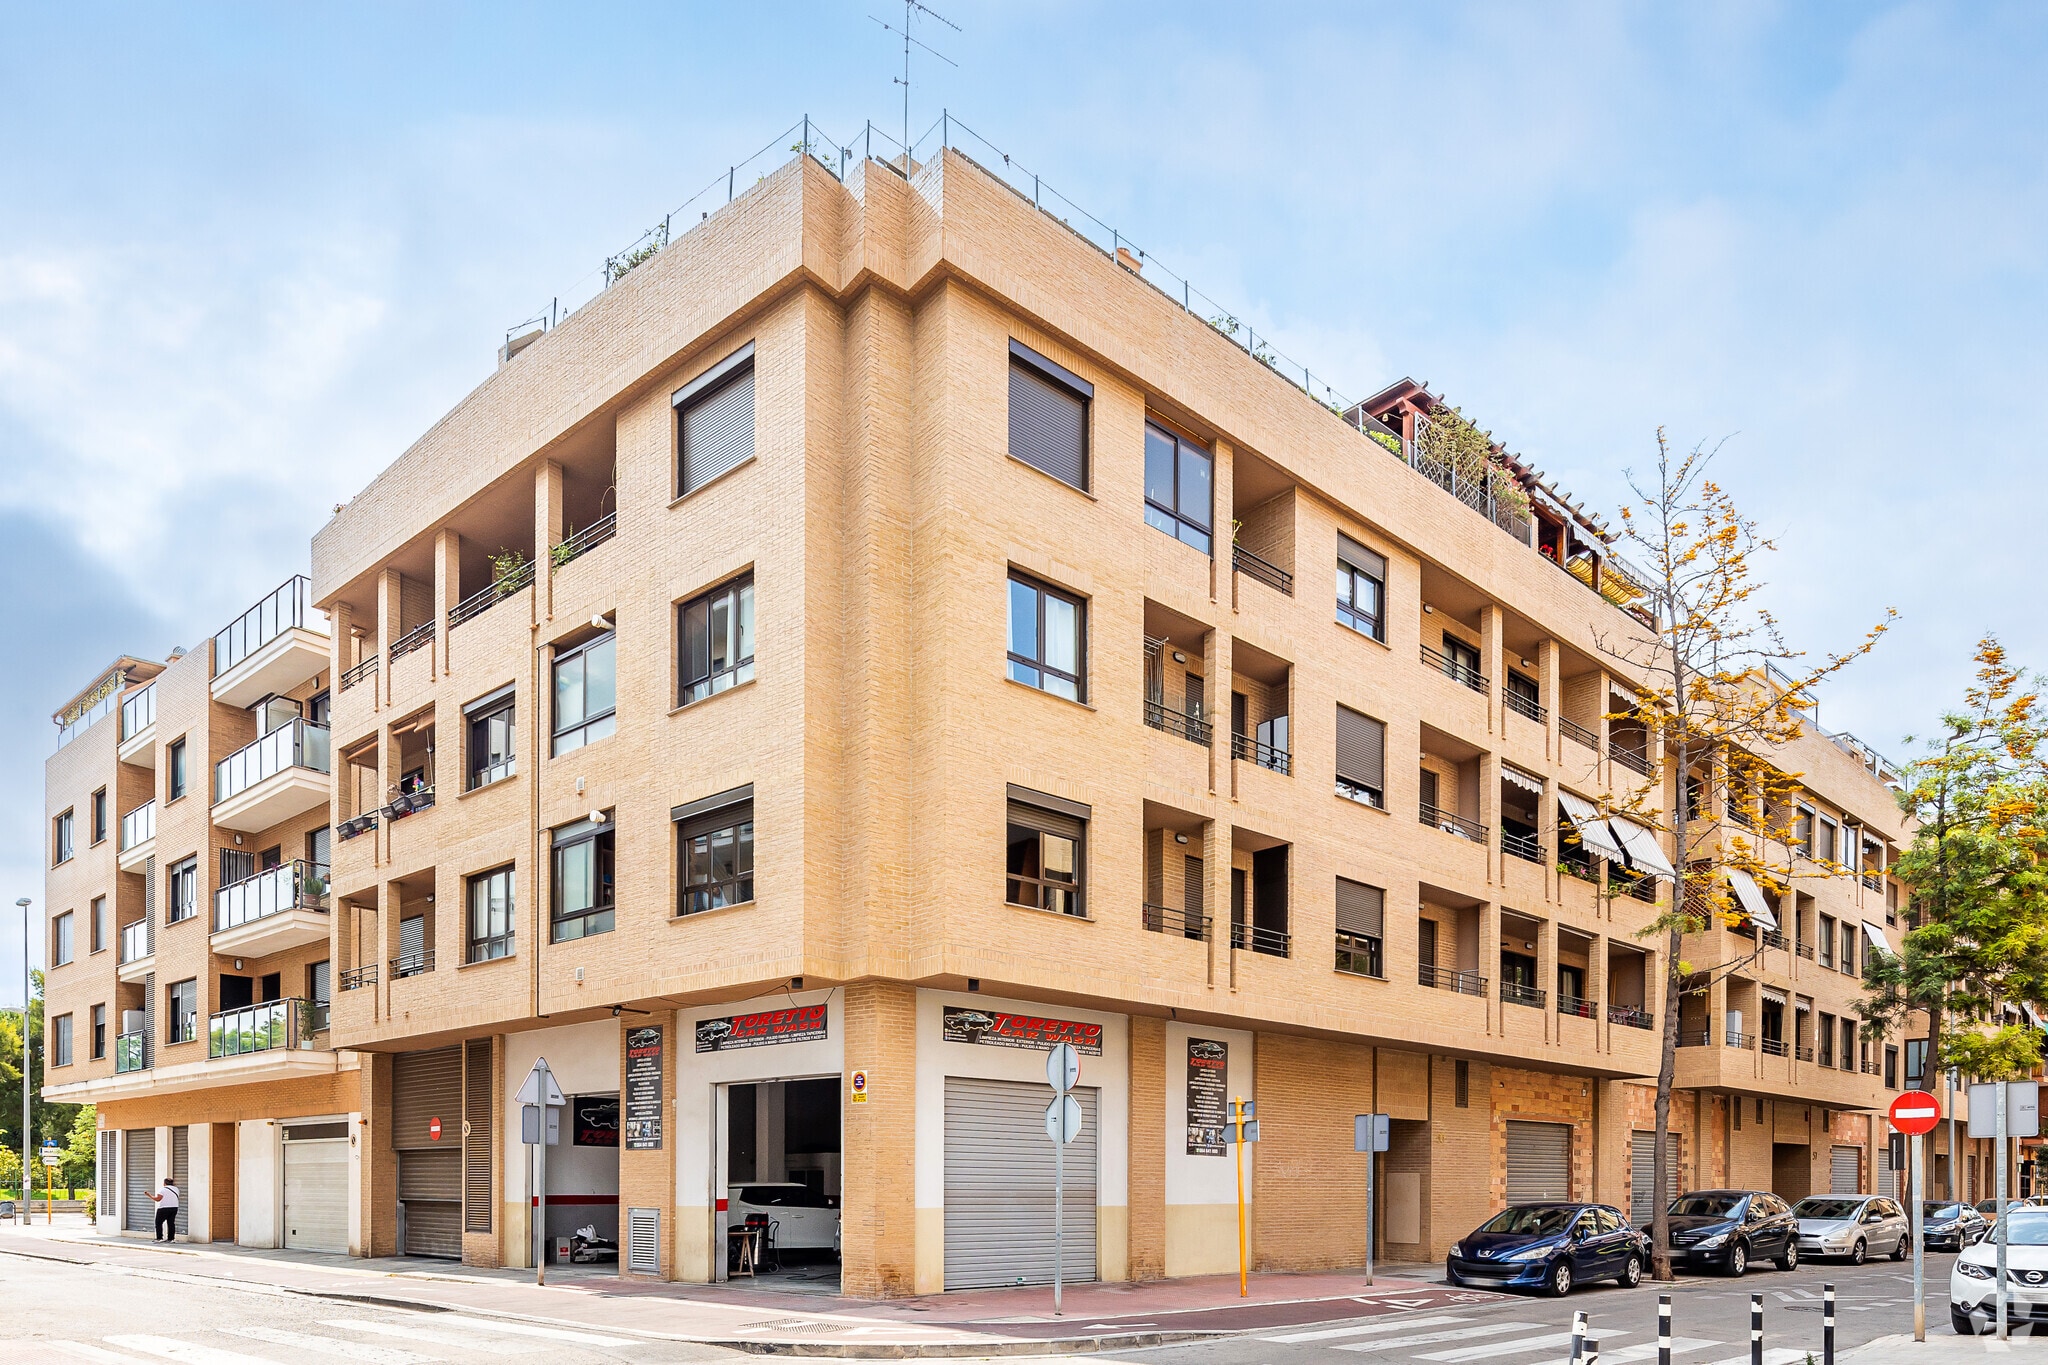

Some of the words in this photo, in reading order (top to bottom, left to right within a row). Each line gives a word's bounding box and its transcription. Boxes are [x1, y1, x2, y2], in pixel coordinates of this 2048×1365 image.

[730, 1005, 826, 1036] TORETTO
[736, 1027, 768, 1038] CAR
[773, 1020, 821, 1034] WASH
[992, 1013, 1101, 1037] TORETTO
[1000, 1028, 1039, 1039] CAR
[1045, 1033, 1097, 1046] WASH
